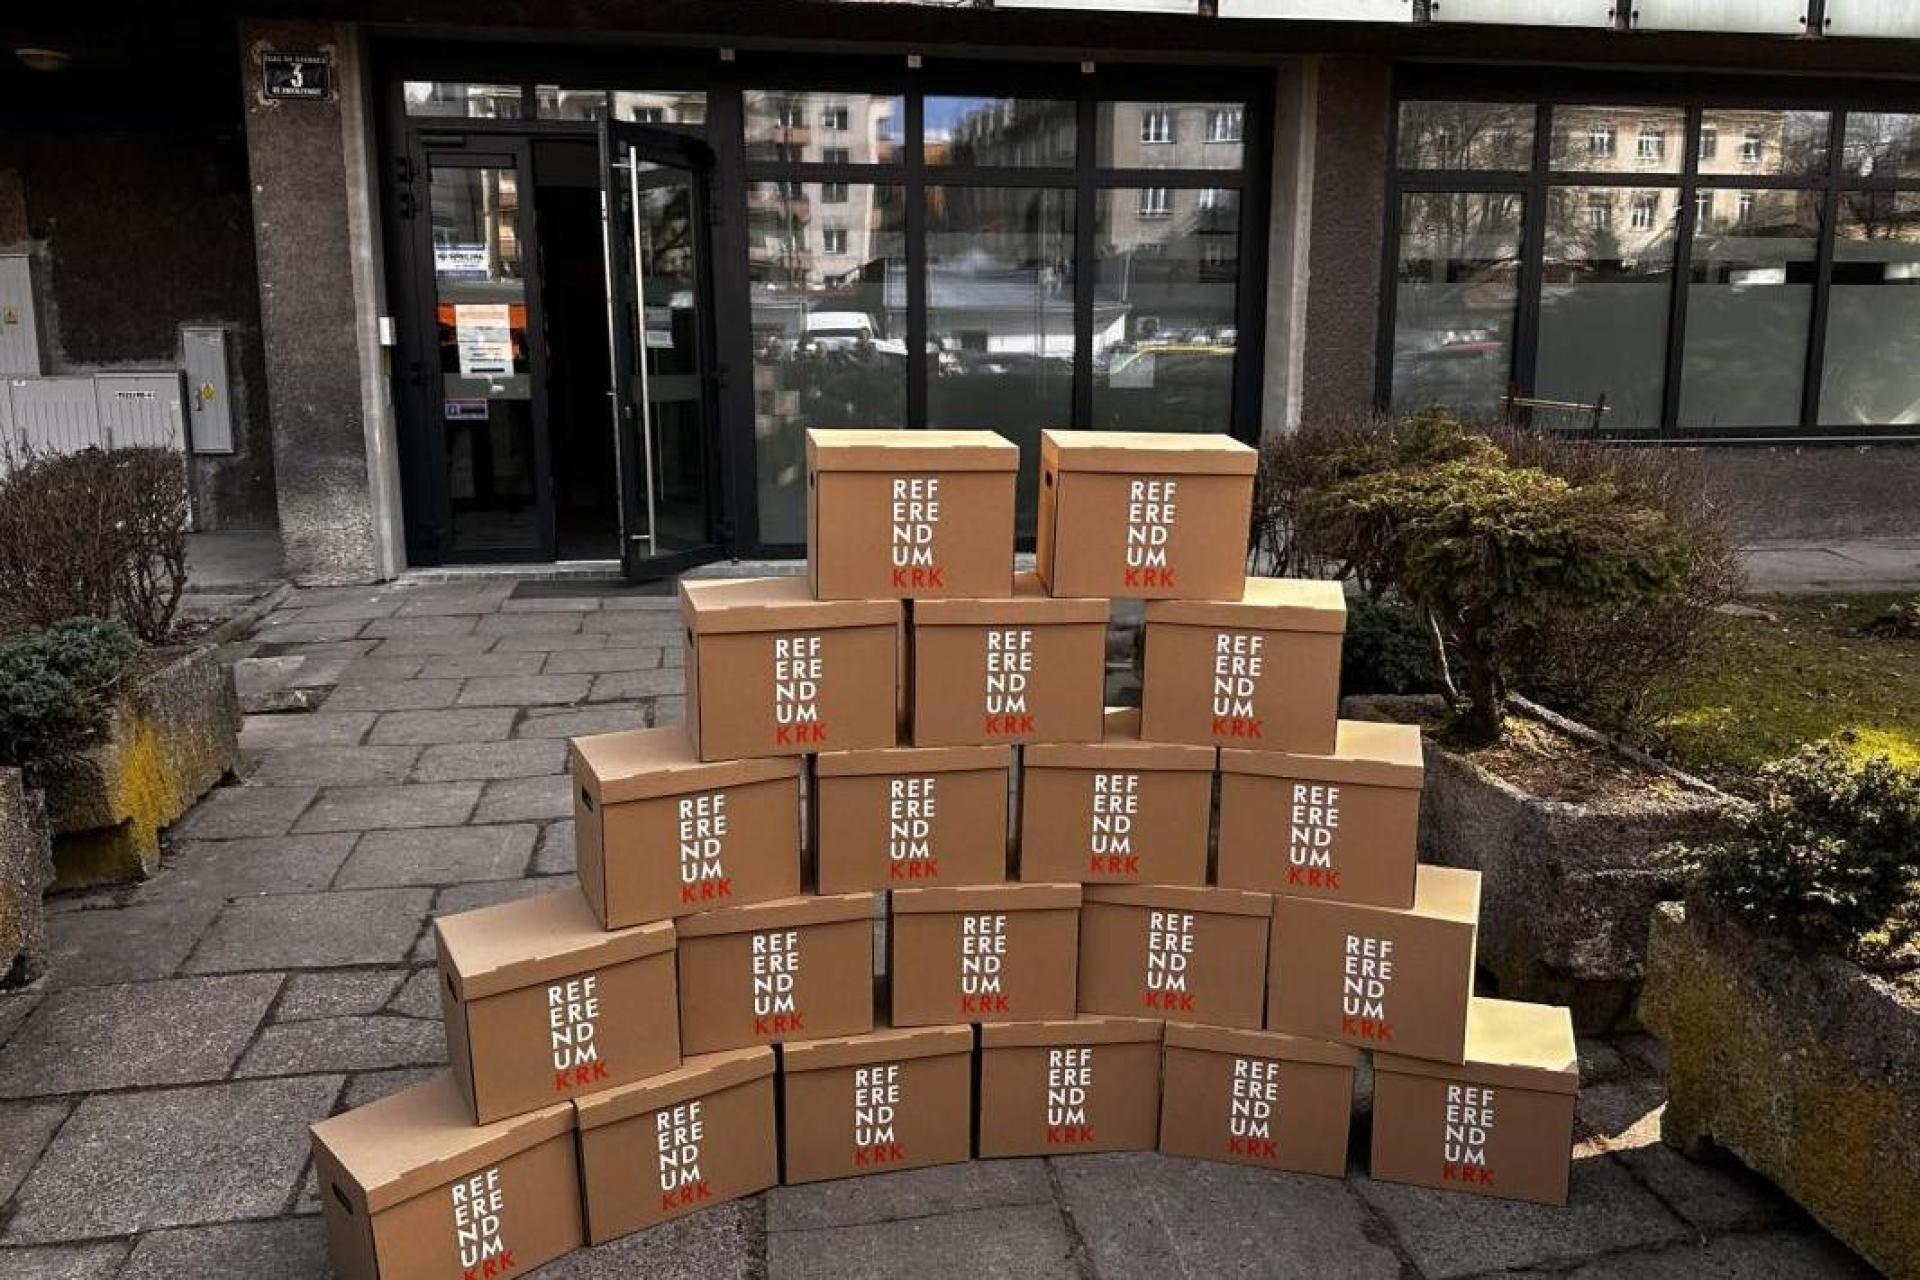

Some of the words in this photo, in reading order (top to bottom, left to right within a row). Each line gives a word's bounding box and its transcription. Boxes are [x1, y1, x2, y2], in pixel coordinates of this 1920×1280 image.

[290, 63, 303, 87] 3
[894, 479, 938, 499] REF
[1131, 481, 1176, 501] REF
[894, 501, 939, 521] ERE
[1130, 503, 1175, 523] ERE
[893, 524, 932, 543] ND
[1128, 525, 1168, 545] ND
[893, 546, 932, 566] UM
[1127, 546, 1166, 567] UM
[892, 567, 942, 588] KRK
[1124, 568, 1173, 586] KRK
[776, 637, 820, 659] REF
[988, 631, 1031, 651] REF
[1217, 634, 1263, 655] REF
[776, 658, 822, 680] ERE
[988, 652, 1032, 671] ERE
[1216, 656, 1262, 676] ERE
[776, 681, 816, 701] ND
[987, 674, 1025, 693] ND
[1215, 676, 1254, 696] ND
[777, 703, 817, 723] UM
[987, 694, 1025, 714] UM
[1214, 697, 1253, 717] UM
[776, 722, 826, 745] KRK
[985, 715, 1033, 735] KRK
[1212, 719, 1260, 736] KRK
[892, 779, 935, 798] REF
[1095, 775, 1138, 793] REF
[1094, 795, 1137, 813] ERE
[1294, 784, 1339, 806] REF
[680, 795, 724, 819] REF
[892, 799, 934, 819] ERE
[1292, 805, 1339, 827] ERE
[681, 815, 726, 840] ERE
[891, 820, 928, 839] ND
[1093, 815, 1130, 833] ND
[1092, 835, 1130, 854] UM
[1292, 826, 1331, 846] ND
[681, 838, 721, 862] ND
[891, 840, 928, 860] UM
[1290, 846, 1330, 867] UM
[682, 859, 721, 883] UM
[890, 860, 938, 880] KRK
[1090, 856, 1138, 874] KRK
[1287, 868, 1338, 888] KRK
[682, 880, 731, 903] KRK
[964, 916, 1006, 934] REF
[1151, 912, 1193, 932] REF
[753, 932, 797, 954] REF
[964, 935, 1006, 954] ERE
[1150, 932, 1193, 952] ERE
[1346, 935, 1392, 958] REF
[753, 952, 798, 974] ERE
[963, 956, 1000, 974] ND
[1149, 952, 1186, 971] ND
[1346, 956, 1391, 979] ERE
[754, 973, 793, 995] ND
[962, 975, 1000, 994] UM
[1148, 971, 1185, 991] UM
[1344, 976, 1384, 998] ND
[548, 977, 595, 1006] REF
[1145, 991, 1192, 1011] KRK
[550, 998, 599, 1028] ERE
[755, 994, 794, 1015] UM
[962, 994, 1007, 1013] KRK
[1344, 997, 1384, 1020] UM
[753, 1014, 804, 1034] KRK
[1342, 1018, 1391, 1040] KRK
[552, 1022, 593, 1049] ND
[554, 1042, 597, 1069] UM
[1050, 1049, 1091, 1067] REF
[554, 1061, 608, 1092] KRK
[856, 1066, 898, 1087] REF
[1049, 1068, 1091, 1087] ERE
[1234, 1060, 1278, 1080] REF
[856, 1085, 899, 1107] ERE
[1049, 1087, 1085, 1105] ND
[1233, 1079, 1278, 1100] ERE
[1449, 1085, 1494, 1106] REF
[658, 1102, 700, 1131] REF
[856, 1106, 894, 1126] ND
[1049, 1107, 1085, 1125] UM
[1232, 1098, 1270, 1118] ND
[1447, 1105, 1493, 1127] ERE
[658, 1121, 703, 1152] ERE
[856, 1124, 894, 1145] UM
[1047, 1126, 1094, 1144] KRK
[1231, 1118, 1269, 1138] UM
[1446, 1124, 1485, 1145] ND
[855, 1143, 903, 1165] KRK
[1229, 1136, 1276, 1158] KRK
[1445, 1143, 1485, 1165] UM
[659, 1145, 698, 1172] ND
[661, 1164, 701, 1190] UM
[1442, 1163, 1494, 1184] KRK
[452, 1168, 498, 1206] REF
[662, 1180, 711, 1211] KRK
[455, 1189, 503, 1226] ERE
[458, 1215, 499, 1247] ND
[461, 1234, 503, 1267] UM
